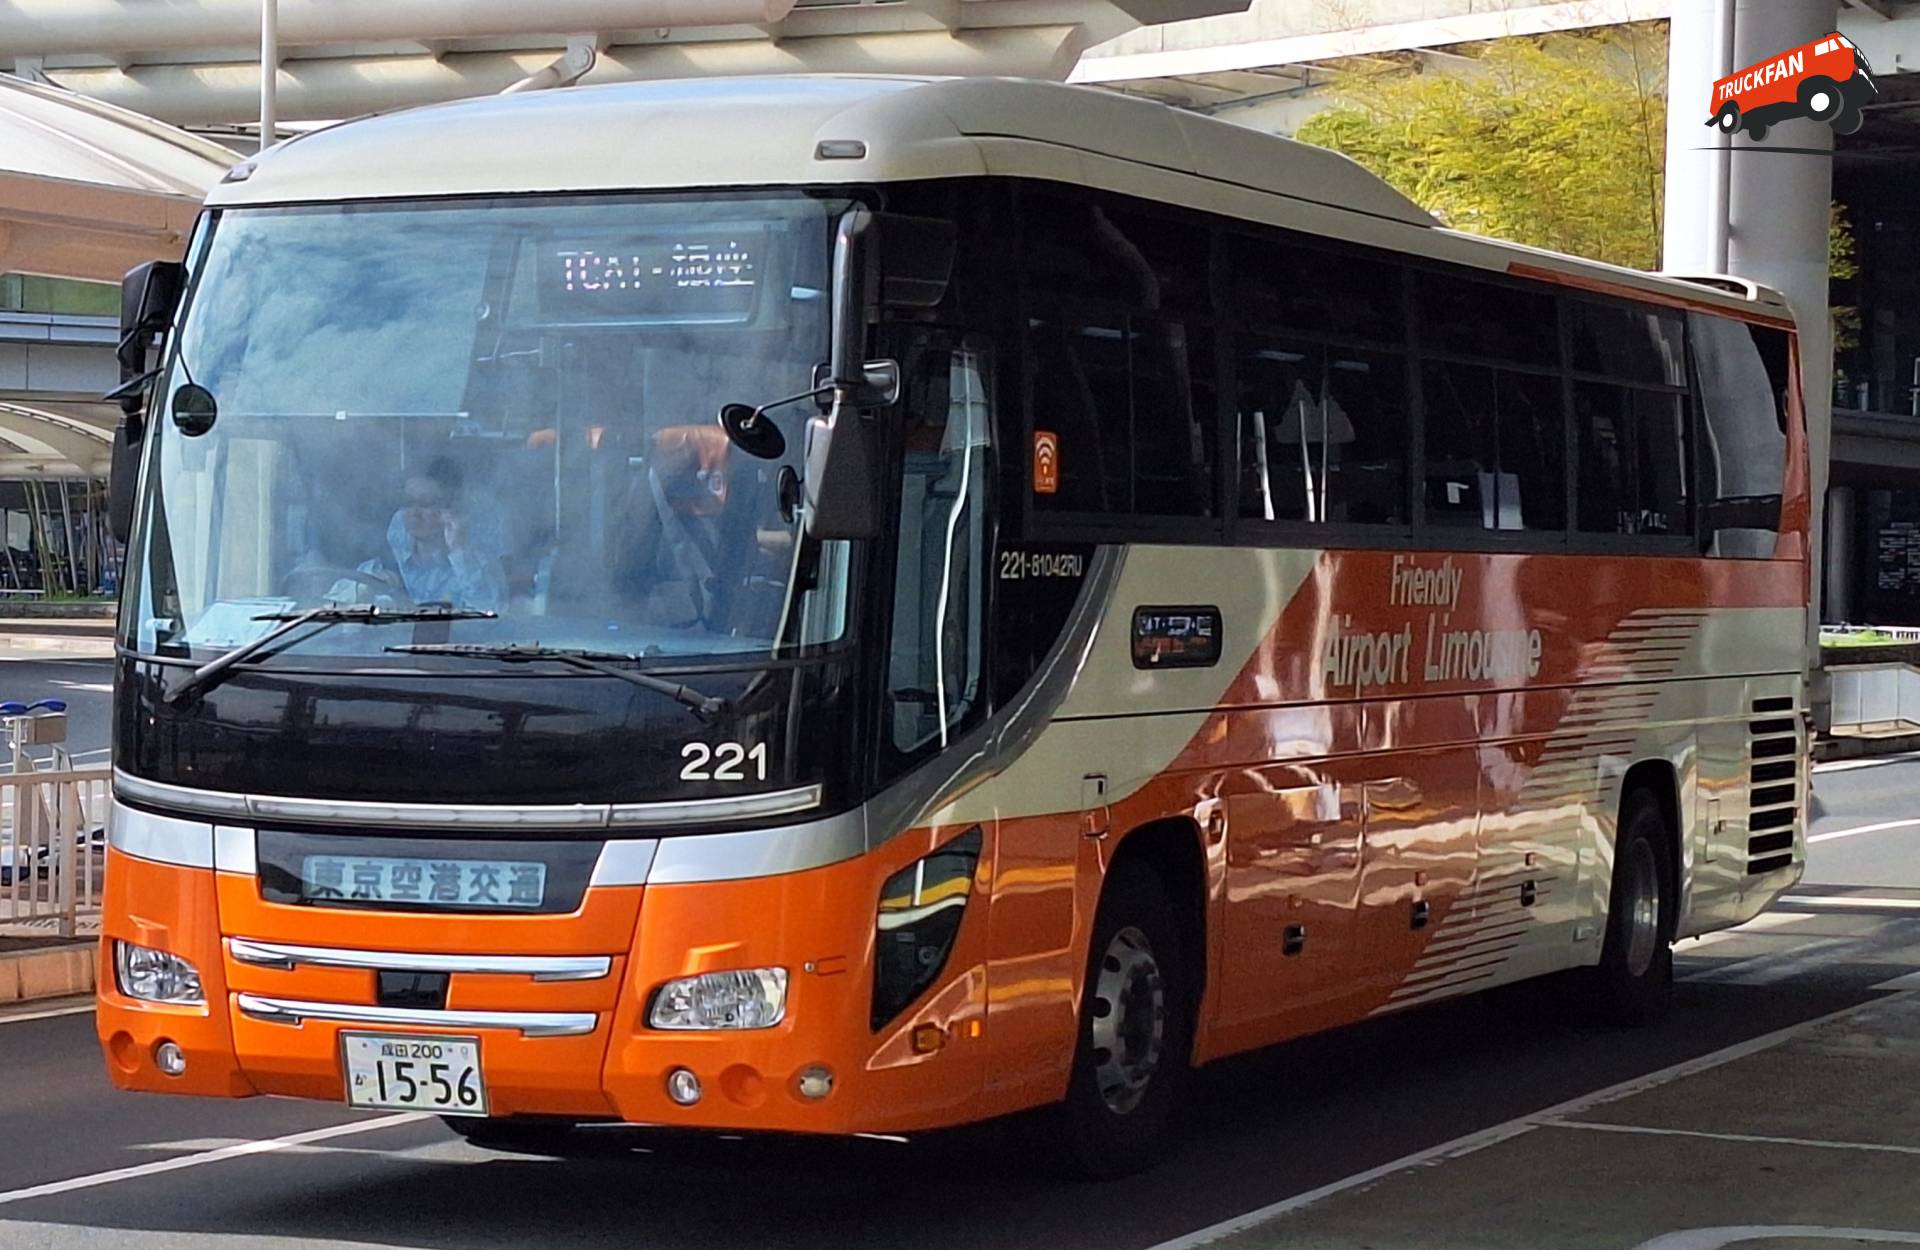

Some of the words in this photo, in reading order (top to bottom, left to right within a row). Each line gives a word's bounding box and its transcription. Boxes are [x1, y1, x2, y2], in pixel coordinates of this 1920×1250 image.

[1390, 555, 1463, 611] Friendly
[1322, 613, 1412, 698] Airport
[1424, 613, 1543, 682] Limoune
[680, 742, 766, 781] 221
[313, 859, 541, 904] 東京空港交通
[412, 1044, 443, 1059] 200
[376, 1060, 478, 1106] 15-56
